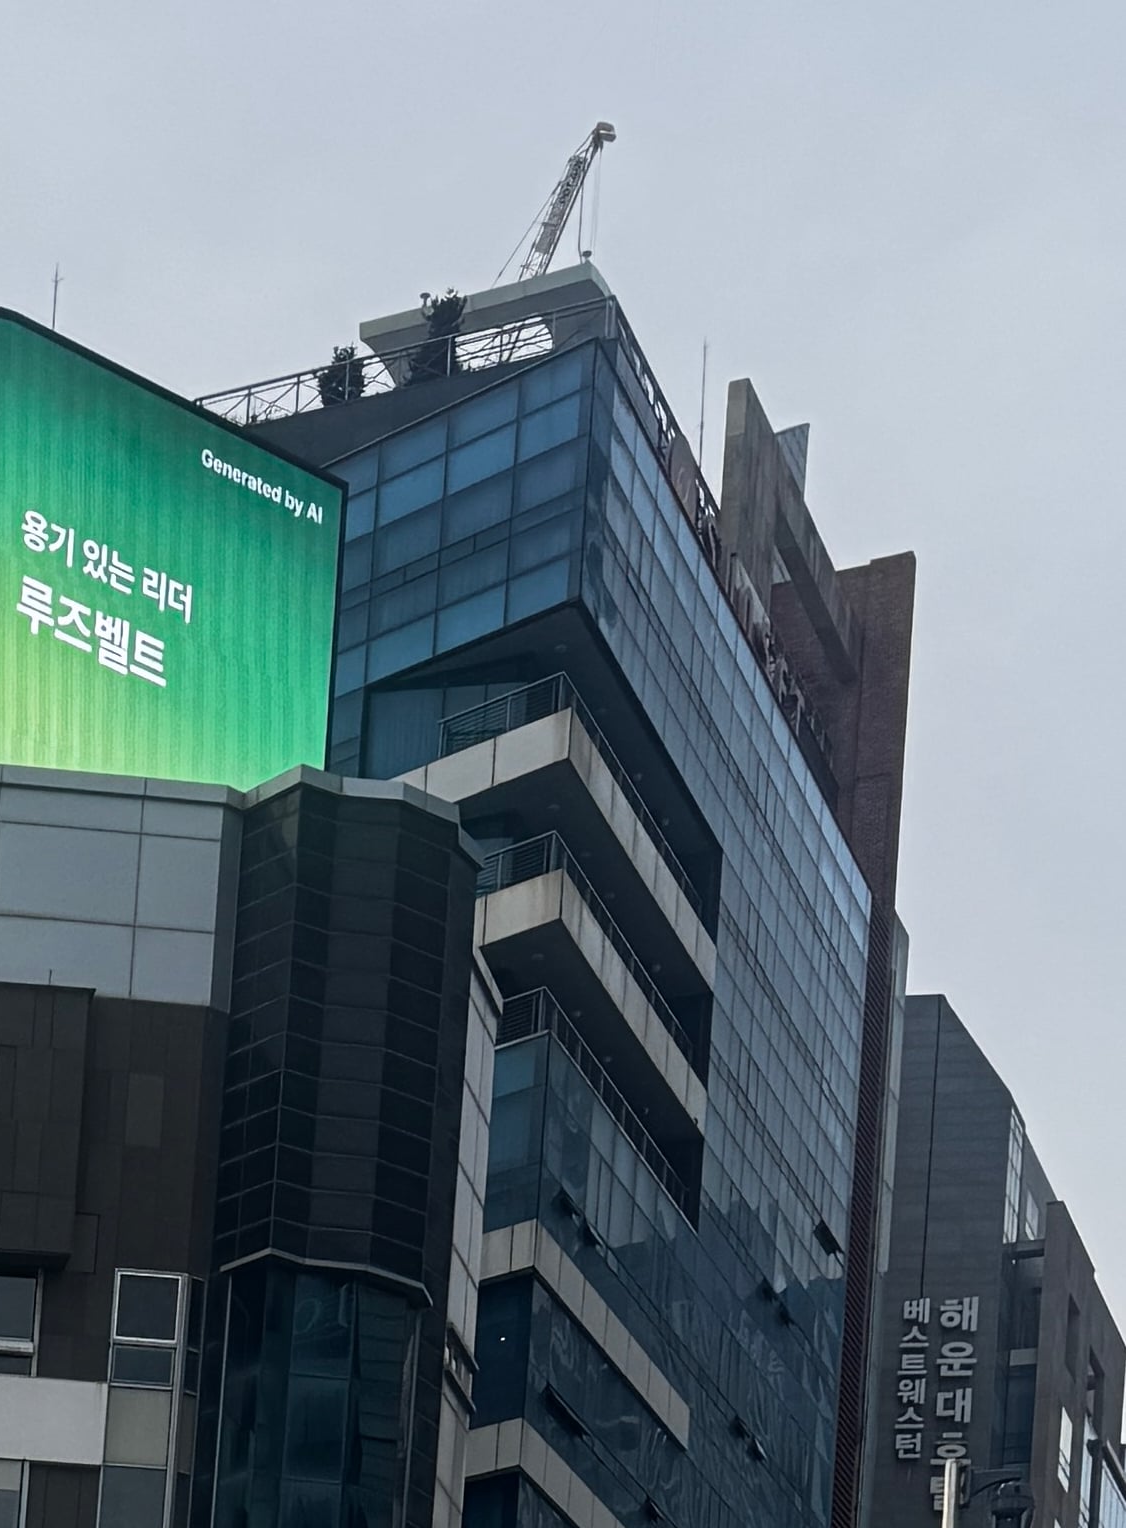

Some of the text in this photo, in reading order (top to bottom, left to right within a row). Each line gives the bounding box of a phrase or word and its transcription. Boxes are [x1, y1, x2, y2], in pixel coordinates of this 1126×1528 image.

[201, 448, 323, 525] Generated by AI
[21, 510, 192, 624] 용기 있는 리더
[16, 575, 167, 688] 루즈벨트
[894, 1298, 930, 1459] 베스트웨스턴
